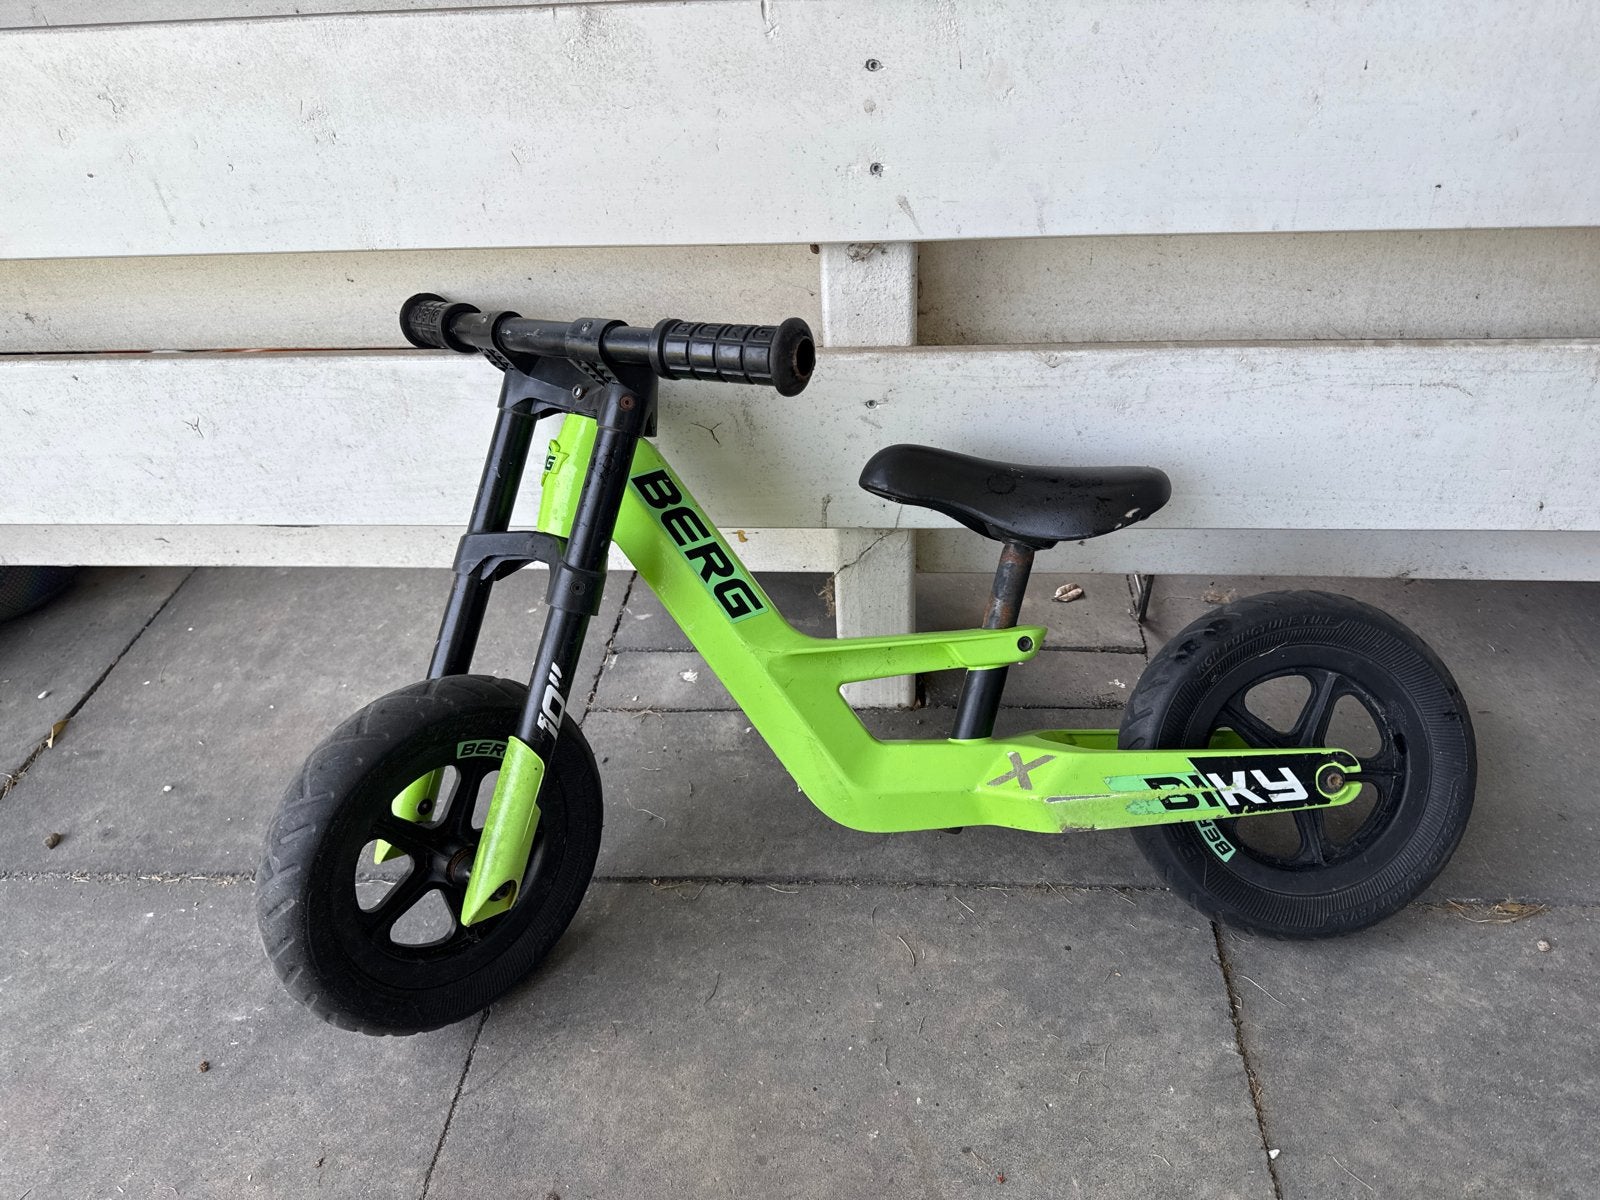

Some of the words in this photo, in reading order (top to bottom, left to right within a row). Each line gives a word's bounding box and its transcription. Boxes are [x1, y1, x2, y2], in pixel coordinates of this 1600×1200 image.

[631, 470, 764, 619] BERG
[460, 742, 508, 757] BER
[1143, 766, 1309, 811] BIKY
